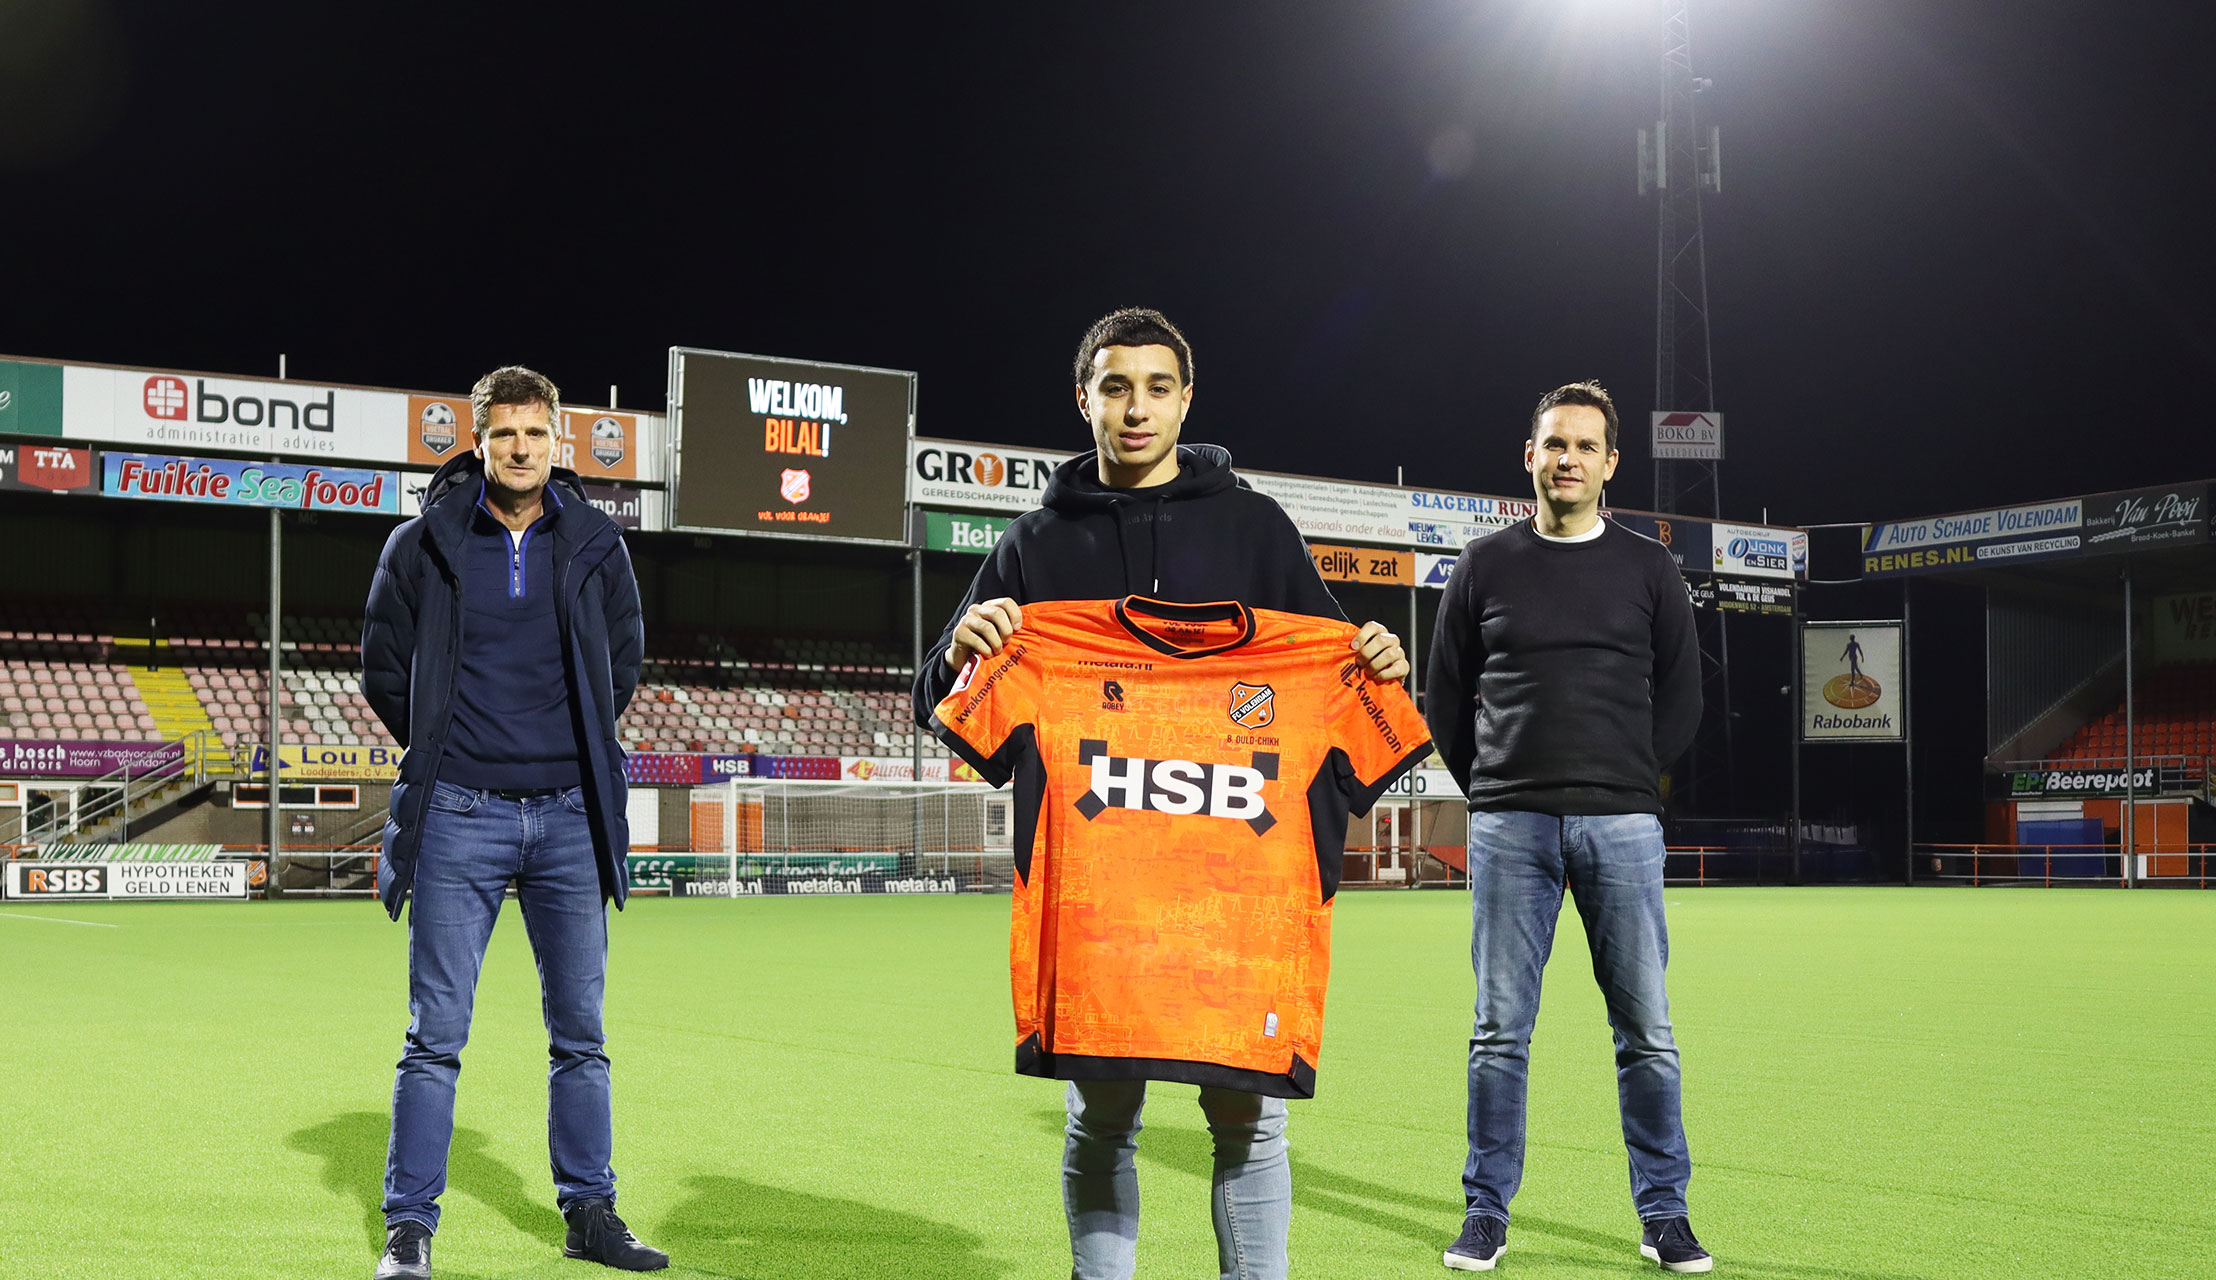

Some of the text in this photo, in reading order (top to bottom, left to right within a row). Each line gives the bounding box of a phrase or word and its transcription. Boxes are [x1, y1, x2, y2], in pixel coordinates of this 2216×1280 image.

[197, 379, 334, 432] bond
[748, 377, 848, 425] WELKOM,
[147, 426, 335, 452] administratie advies
[765, 418, 830, 457] BILAL!
[1657, 427, 1715, 440] BOKO BV
[34, 450, 76, 470] TTA
[119, 460, 384, 509] Fuikie Seafood
[922, 487, 1020, 503] GEREEDSCHAPPEN
[1411, 492, 1493, 514] SLAGERIJ
[1345, 521, 1374, 535] onder
[1377, 525, 1407, 538] elkaar
[1408, 522, 1436, 533] NIEUW
[2087, 515, 2115, 527] Bakkerij
[1416, 532, 1443, 545] LEVEN
[1750, 541, 1784, 554] JONK
[1978, 537, 2079, 558] DE KUNST VAN RECYCLING
[1313, 551, 1398, 579] elijk zat
[1865, 547, 1974, 573] RENES.NL
[1700, 590, 1715, 599] GEUS
[1719, 583, 1760, 593] VOLENDAMMER
[1761, 586, 1791, 597] VISHANDEL
[955, 644, 1027, 725] kwakmangroep.nl
[1102, 702, 1125, 711] ROBEY
[1231, 711, 1242, 721] FC
[1240, 688, 1273, 714] VOLENDAM
[1355, 680, 1402, 754] kwakman
[1813, 713, 1892, 729] Rabobank
[1236, 735, 1280, 746] OULD-CHIKH
[15, 744, 66, 760] bosch
[302, 746, 357, 765] Lou
[70, 757, 100, 767] Hoorn
[713, 759, 750, 774] HSB
[1090, 755, 1265, 819] HSB
[28, 868, 101, 892] RSBS
[121, 865, 234, 878] HYPOTHEKEN
[125, 881, 230, 893] GELD LENEN
[686, 877, 762, 895] metaa.nl
[787, 877, 861, 893] metafa.nl
[884, 876, 956, 893] metafa.nl
